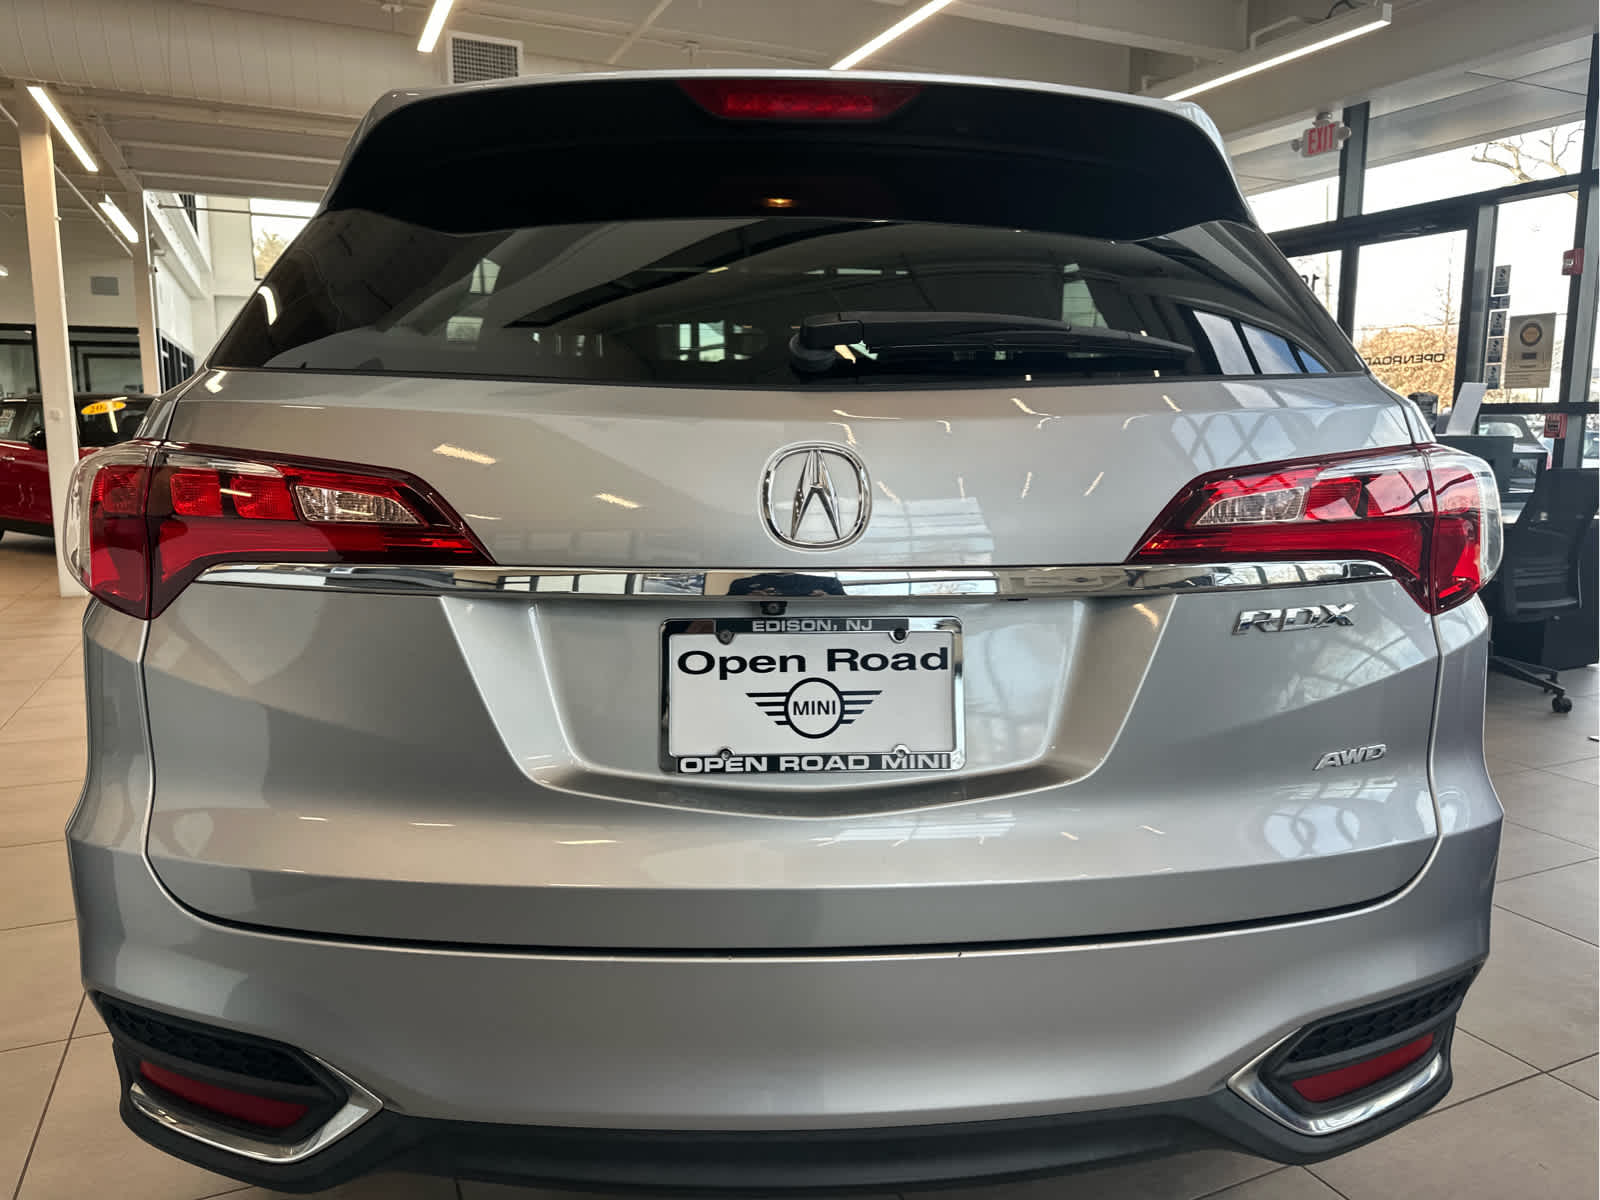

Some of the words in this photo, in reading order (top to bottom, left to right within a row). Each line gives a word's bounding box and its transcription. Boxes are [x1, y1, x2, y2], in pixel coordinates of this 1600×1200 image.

[1307, 123, 1337, 154] EXIT
[752, 619, 837, 632] EDISON,
[845, 619, 873, 631] NJ
[1231, 602, 1359, 636] RDX
[677, 650, 806, 680] Open
[827, 647, 949, 672] Road
[792, 700, 837, 716] MINI
[679, 755, 768, 773] OPEN
[779, 754, 870, 772] ROAD
[881, 753, 949, 770] MINI
[1312, 744, 1387, 771] AWD
